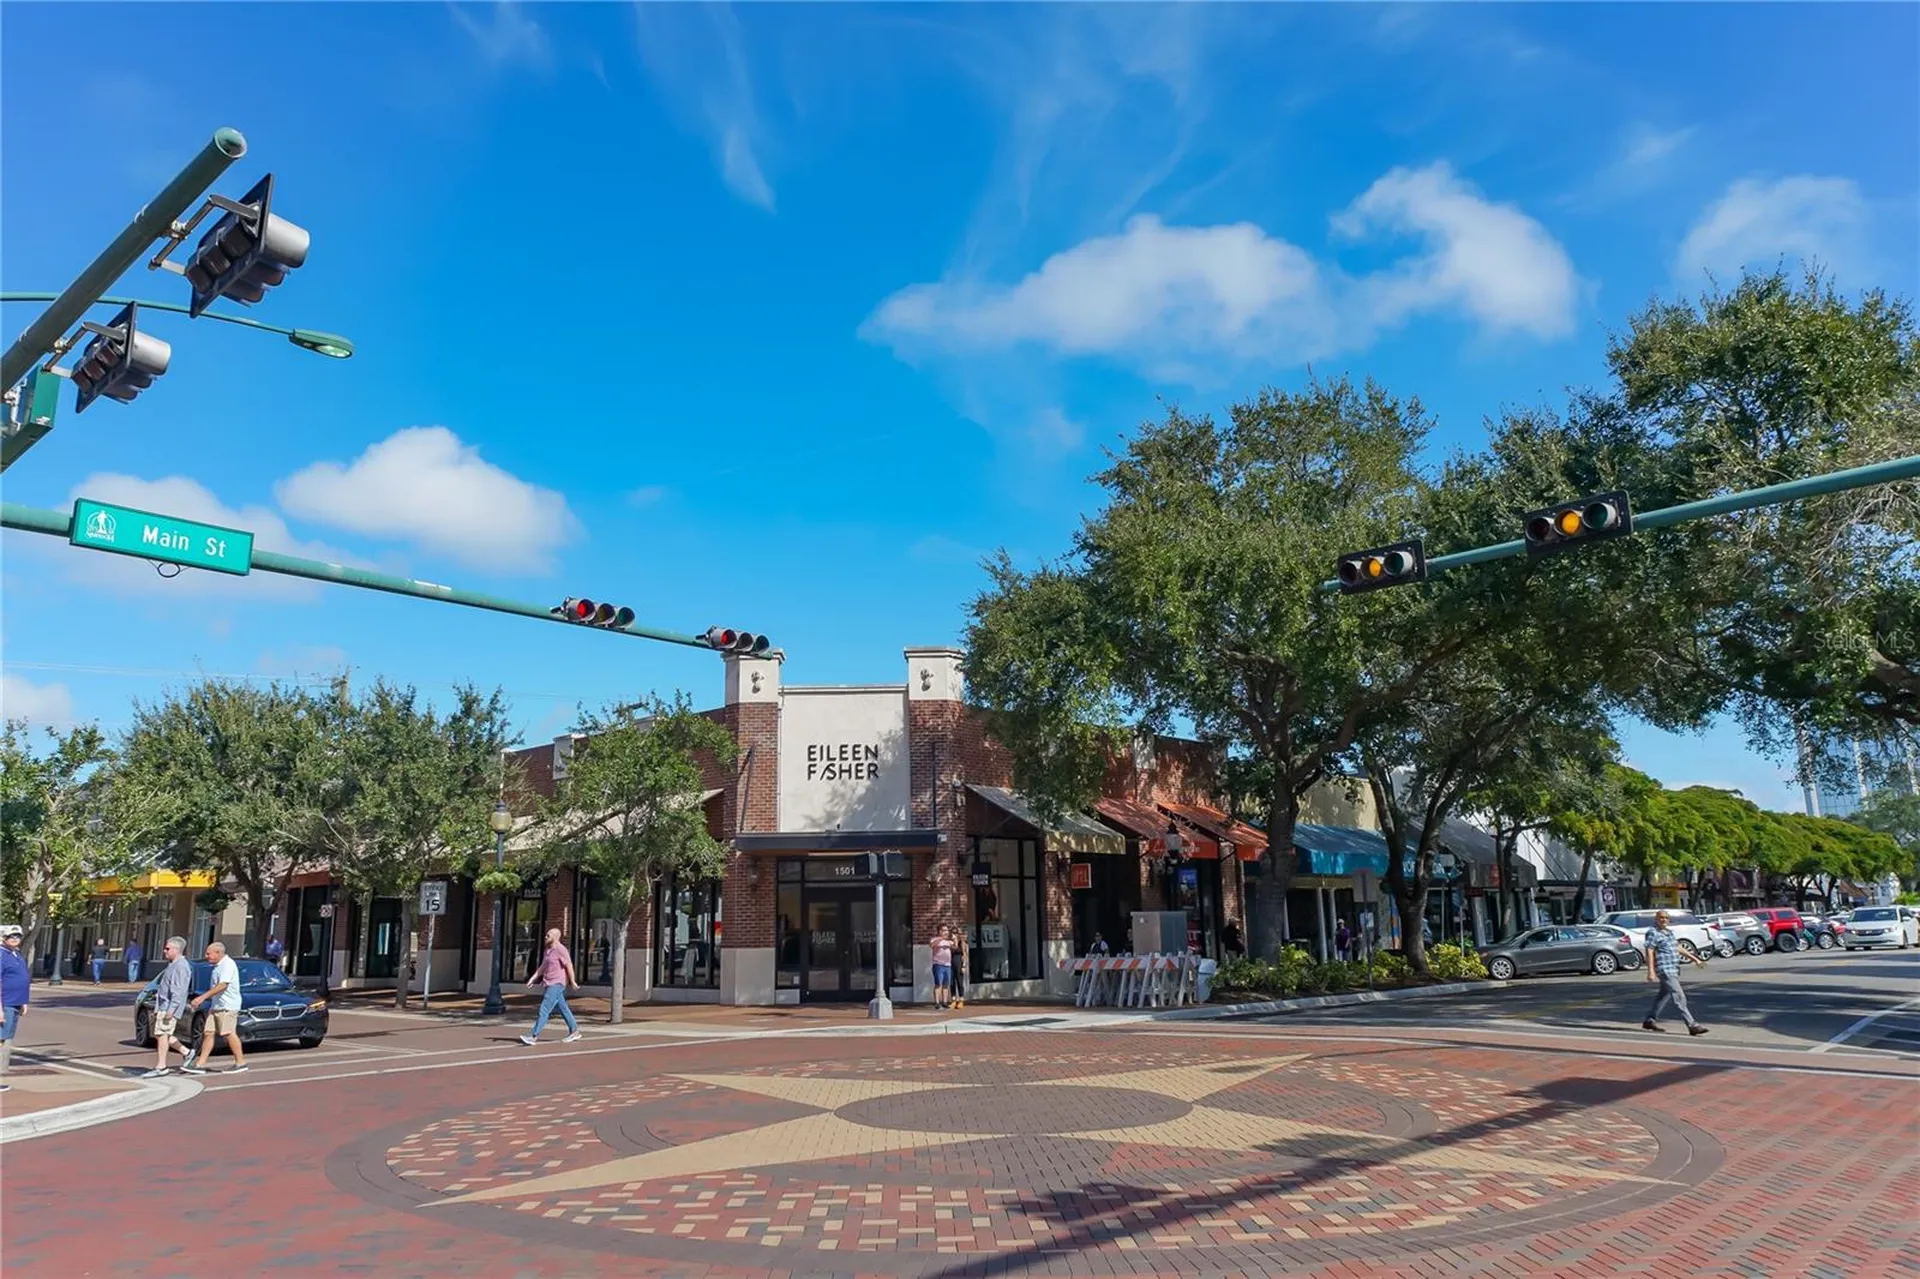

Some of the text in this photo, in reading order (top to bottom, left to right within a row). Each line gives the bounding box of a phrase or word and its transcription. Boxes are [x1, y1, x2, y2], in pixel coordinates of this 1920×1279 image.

[142, 524, 227, 558] Main St
[808, 744, 878, 761] EILEEN
[808, 763, 879, 781] FISHER
[835, 866, 855, 875] 1501
[426, 900, 440, 911] 15
